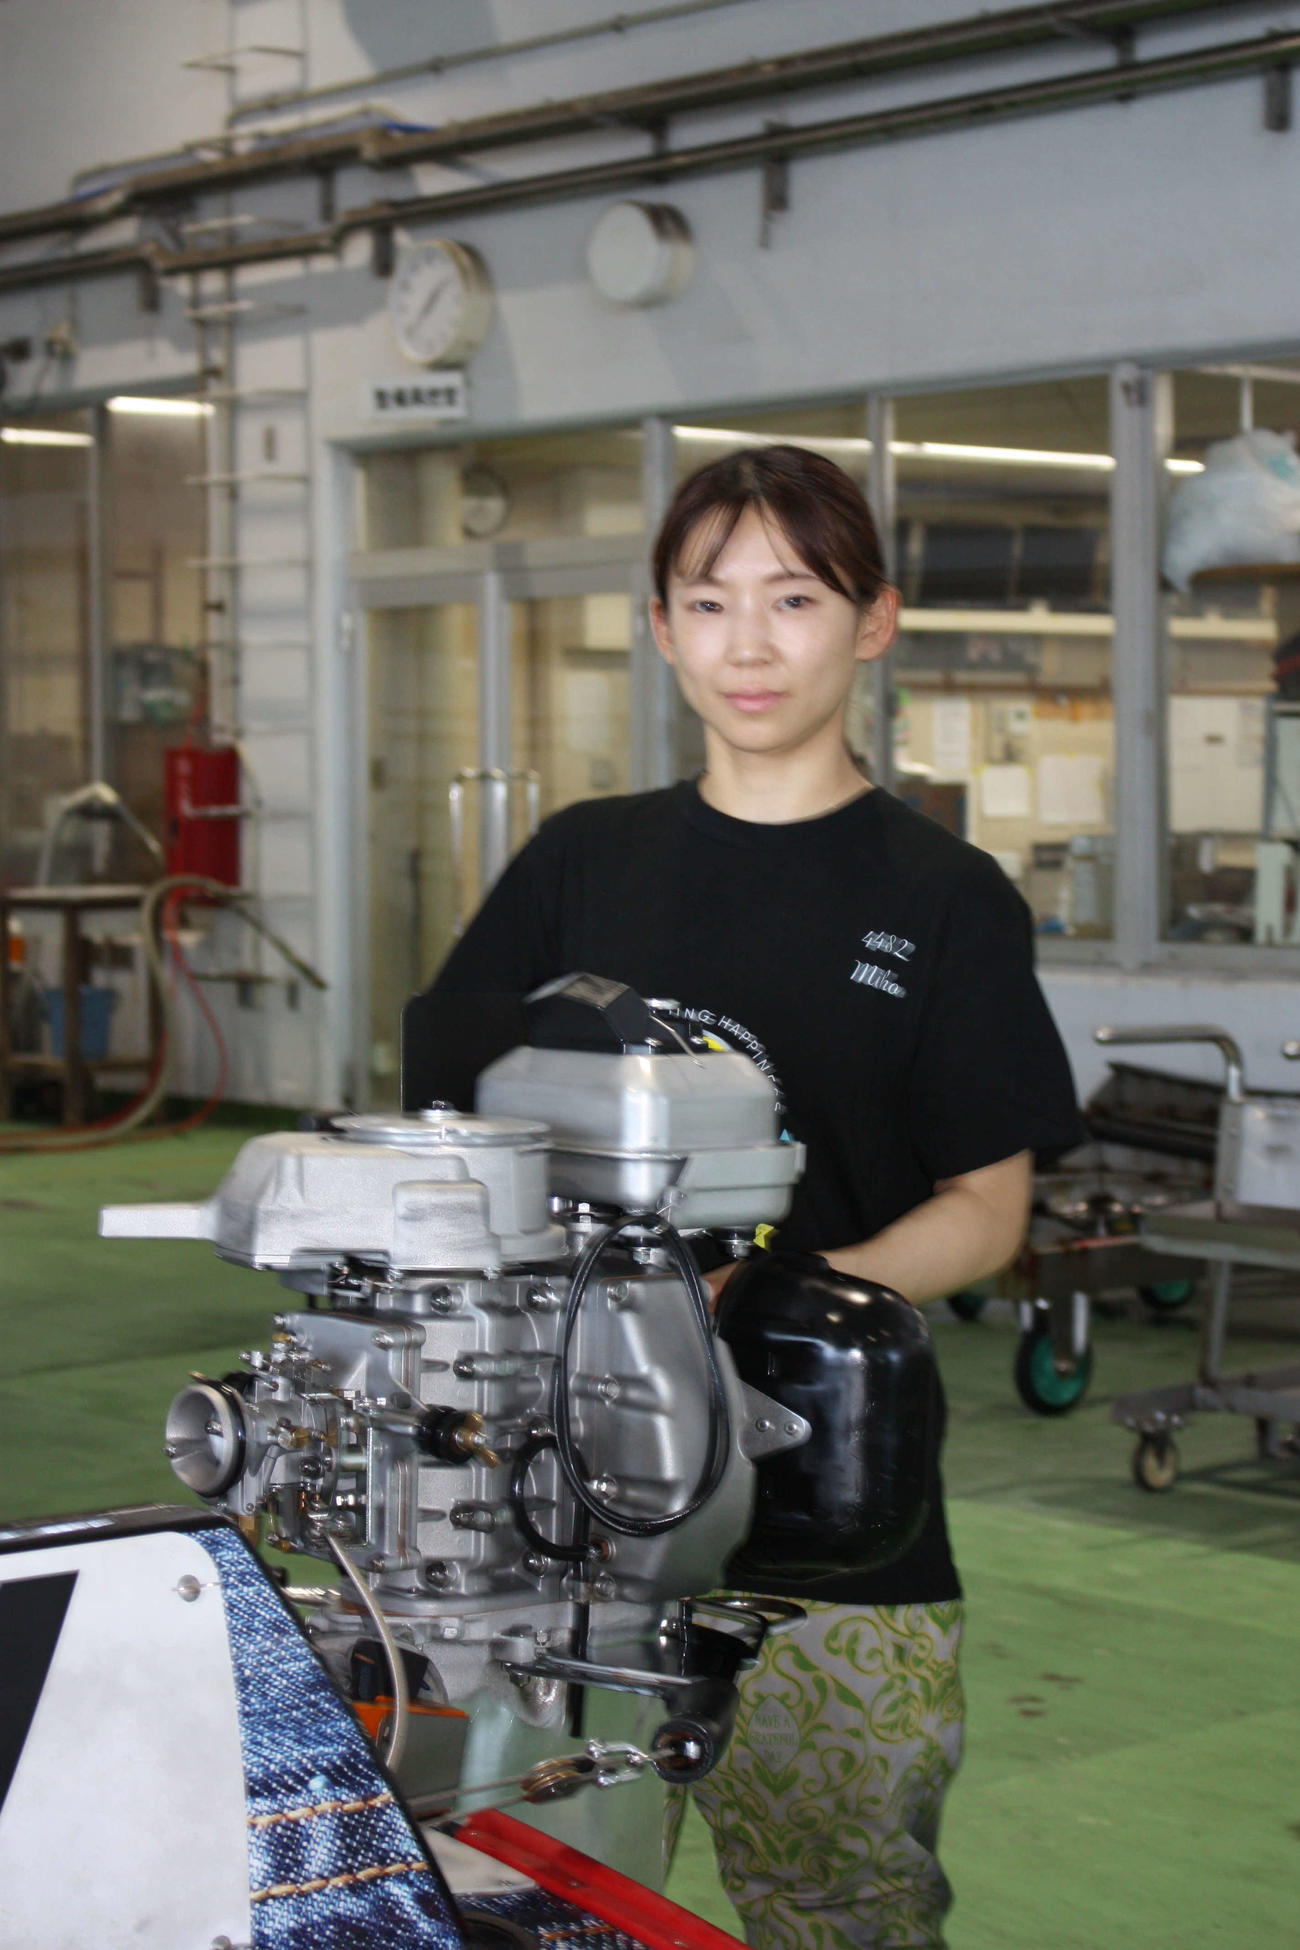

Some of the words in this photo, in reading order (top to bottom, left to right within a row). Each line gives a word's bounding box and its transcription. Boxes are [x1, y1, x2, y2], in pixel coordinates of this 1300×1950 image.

[861, 931, 914, 962] 4482
[850, 960, 903, 996] Miho
[755, 1714, 781, 1728] HAVE
